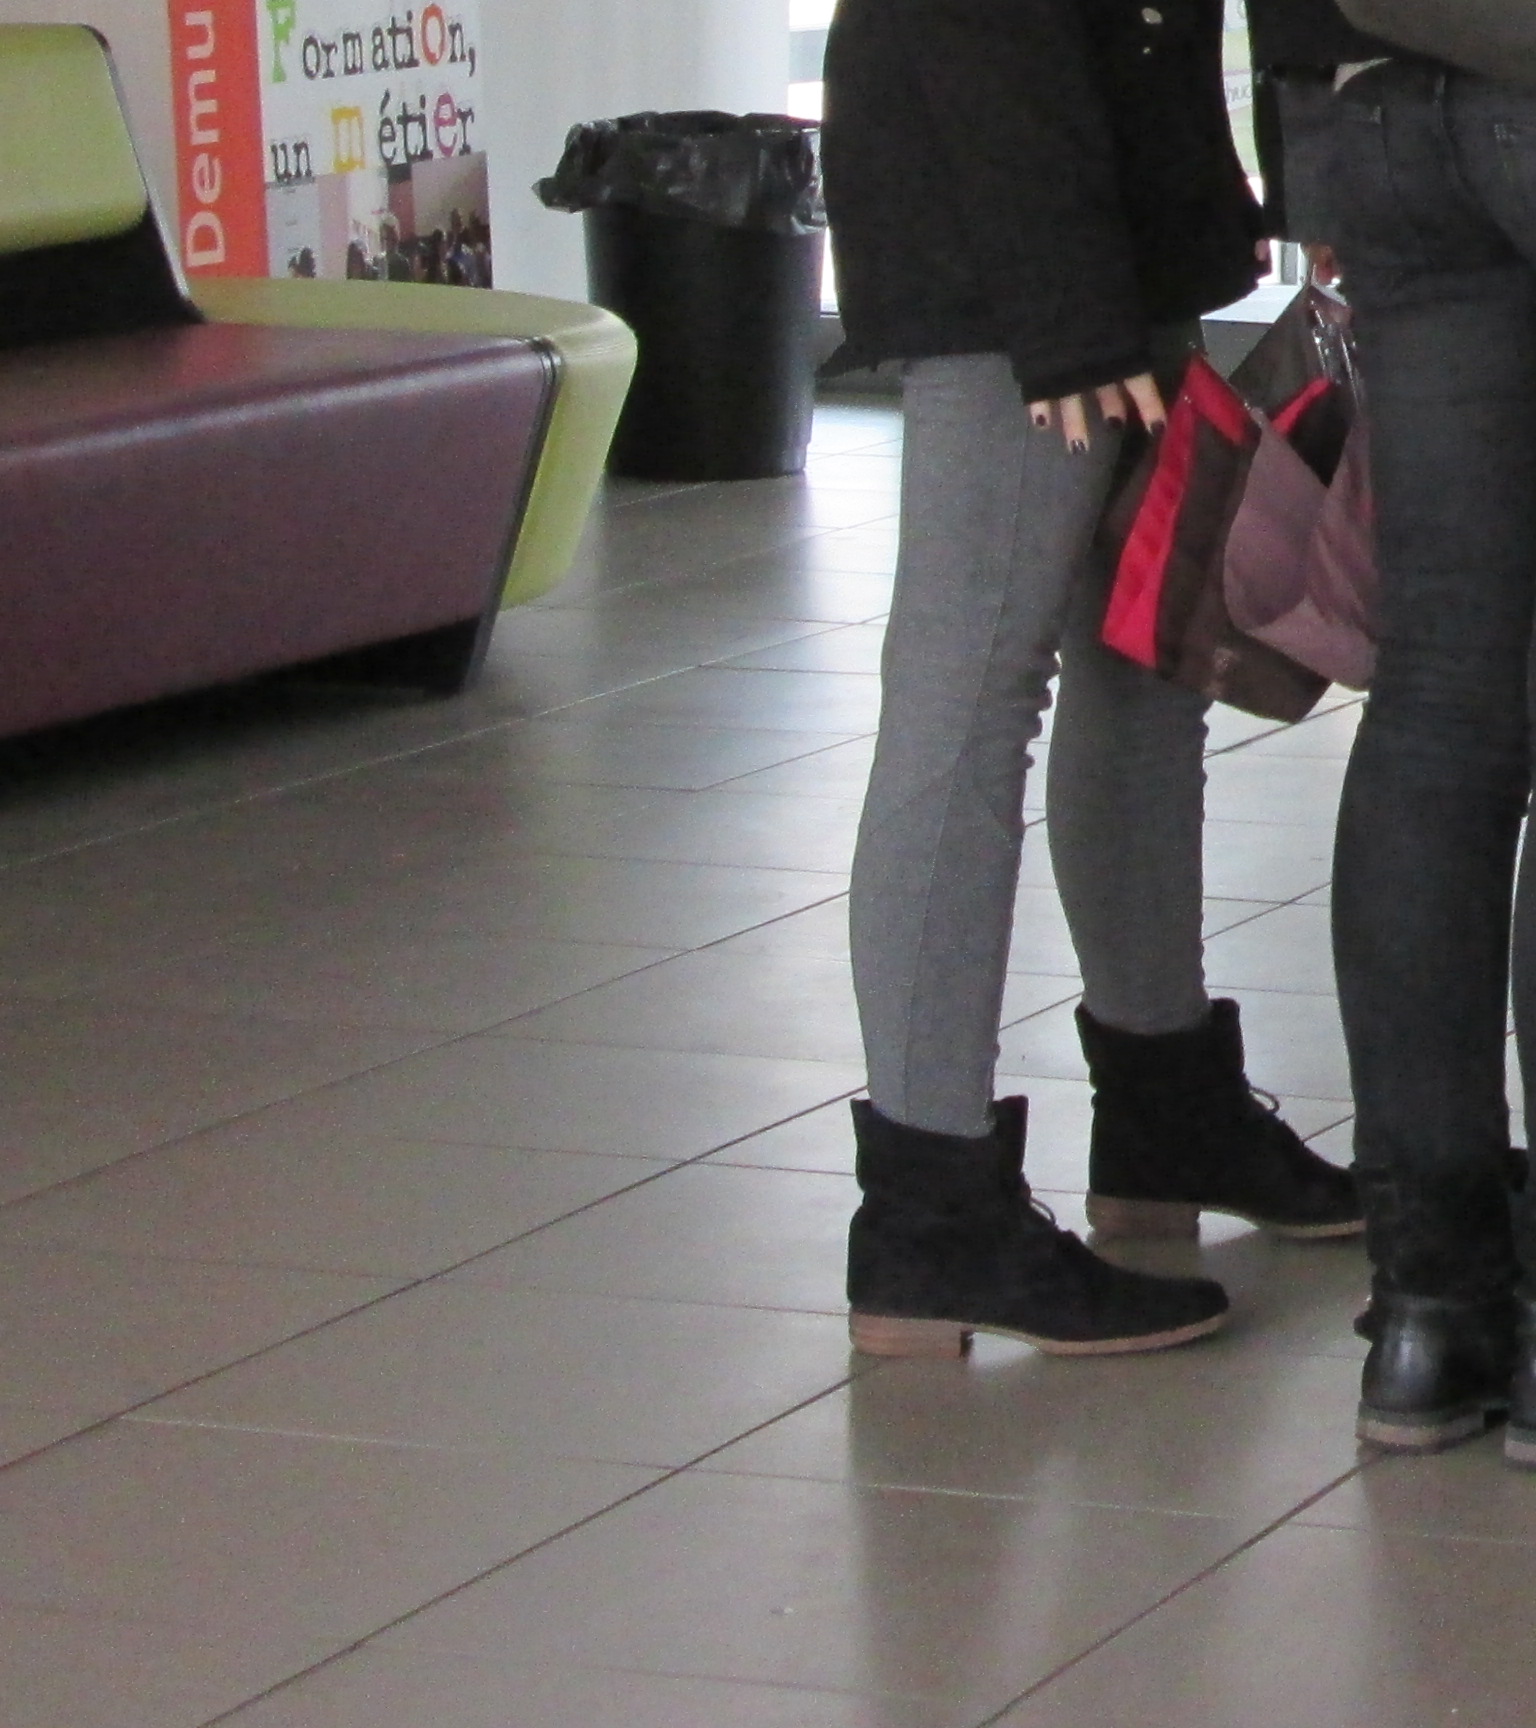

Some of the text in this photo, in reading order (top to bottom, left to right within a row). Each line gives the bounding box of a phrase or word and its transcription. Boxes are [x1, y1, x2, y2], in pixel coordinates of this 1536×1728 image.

[184, 10, 226, 269] Demu
[270, 87, 476, 185] un métier
